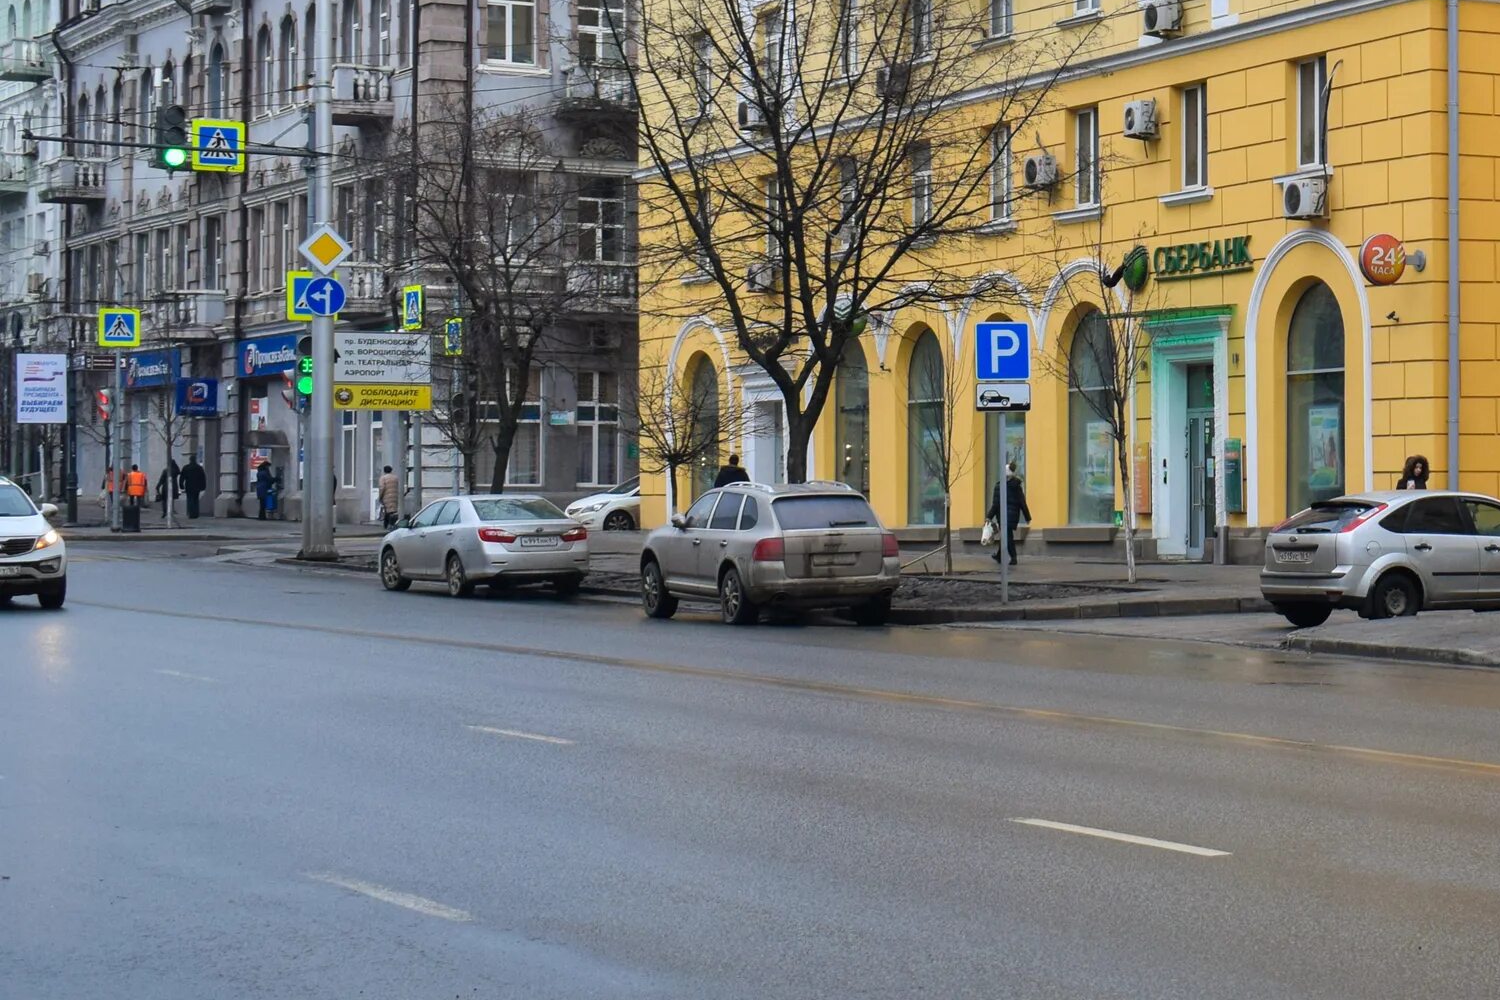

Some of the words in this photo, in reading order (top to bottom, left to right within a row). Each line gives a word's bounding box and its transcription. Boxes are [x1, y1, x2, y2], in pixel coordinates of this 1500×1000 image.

[1154, 235, 1253, 275] СБЕРБАНК
[1371, 246, 1396, 266] 24
[1370, 265, 1395, 275] ЧАСА
[357, 348, 427, 357] ВОРОШИЛОВСКИЙ
[990, 329, 1020, 374] P
[360, 388, 420, 397] СОБЛЮДАЙТЕ
[359, 398, 416, 406] ДИСТАНЦИЮ!
